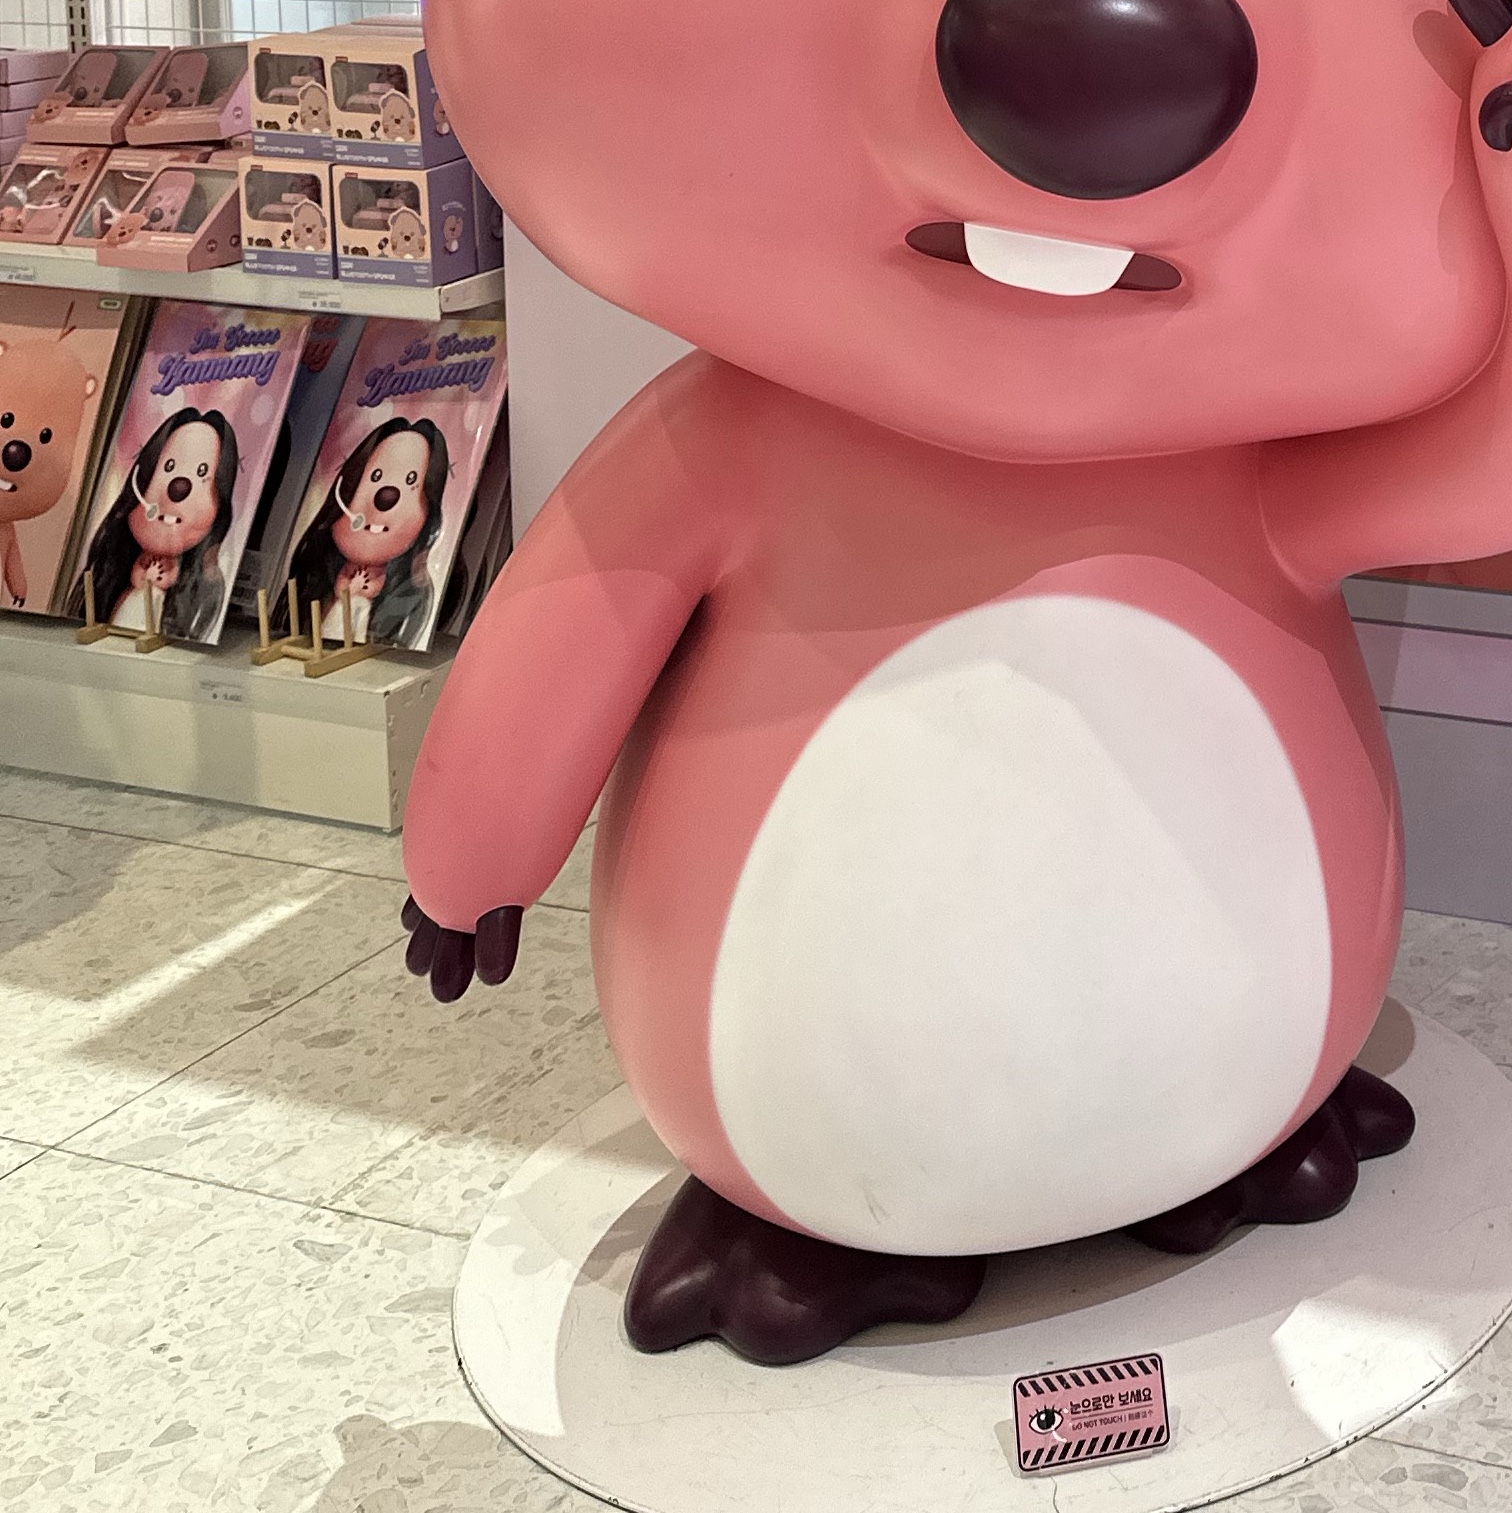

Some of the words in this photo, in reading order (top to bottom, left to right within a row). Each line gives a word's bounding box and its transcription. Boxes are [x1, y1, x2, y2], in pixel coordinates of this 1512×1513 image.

[1069, 1394, 1114, 1415] 눈으로만
[1118, 1387, 1153, 1407] 보세요
[1083, 1419, 1097, 1429] NOT
[1098, 1414, 1122, 1426] TOUCH
